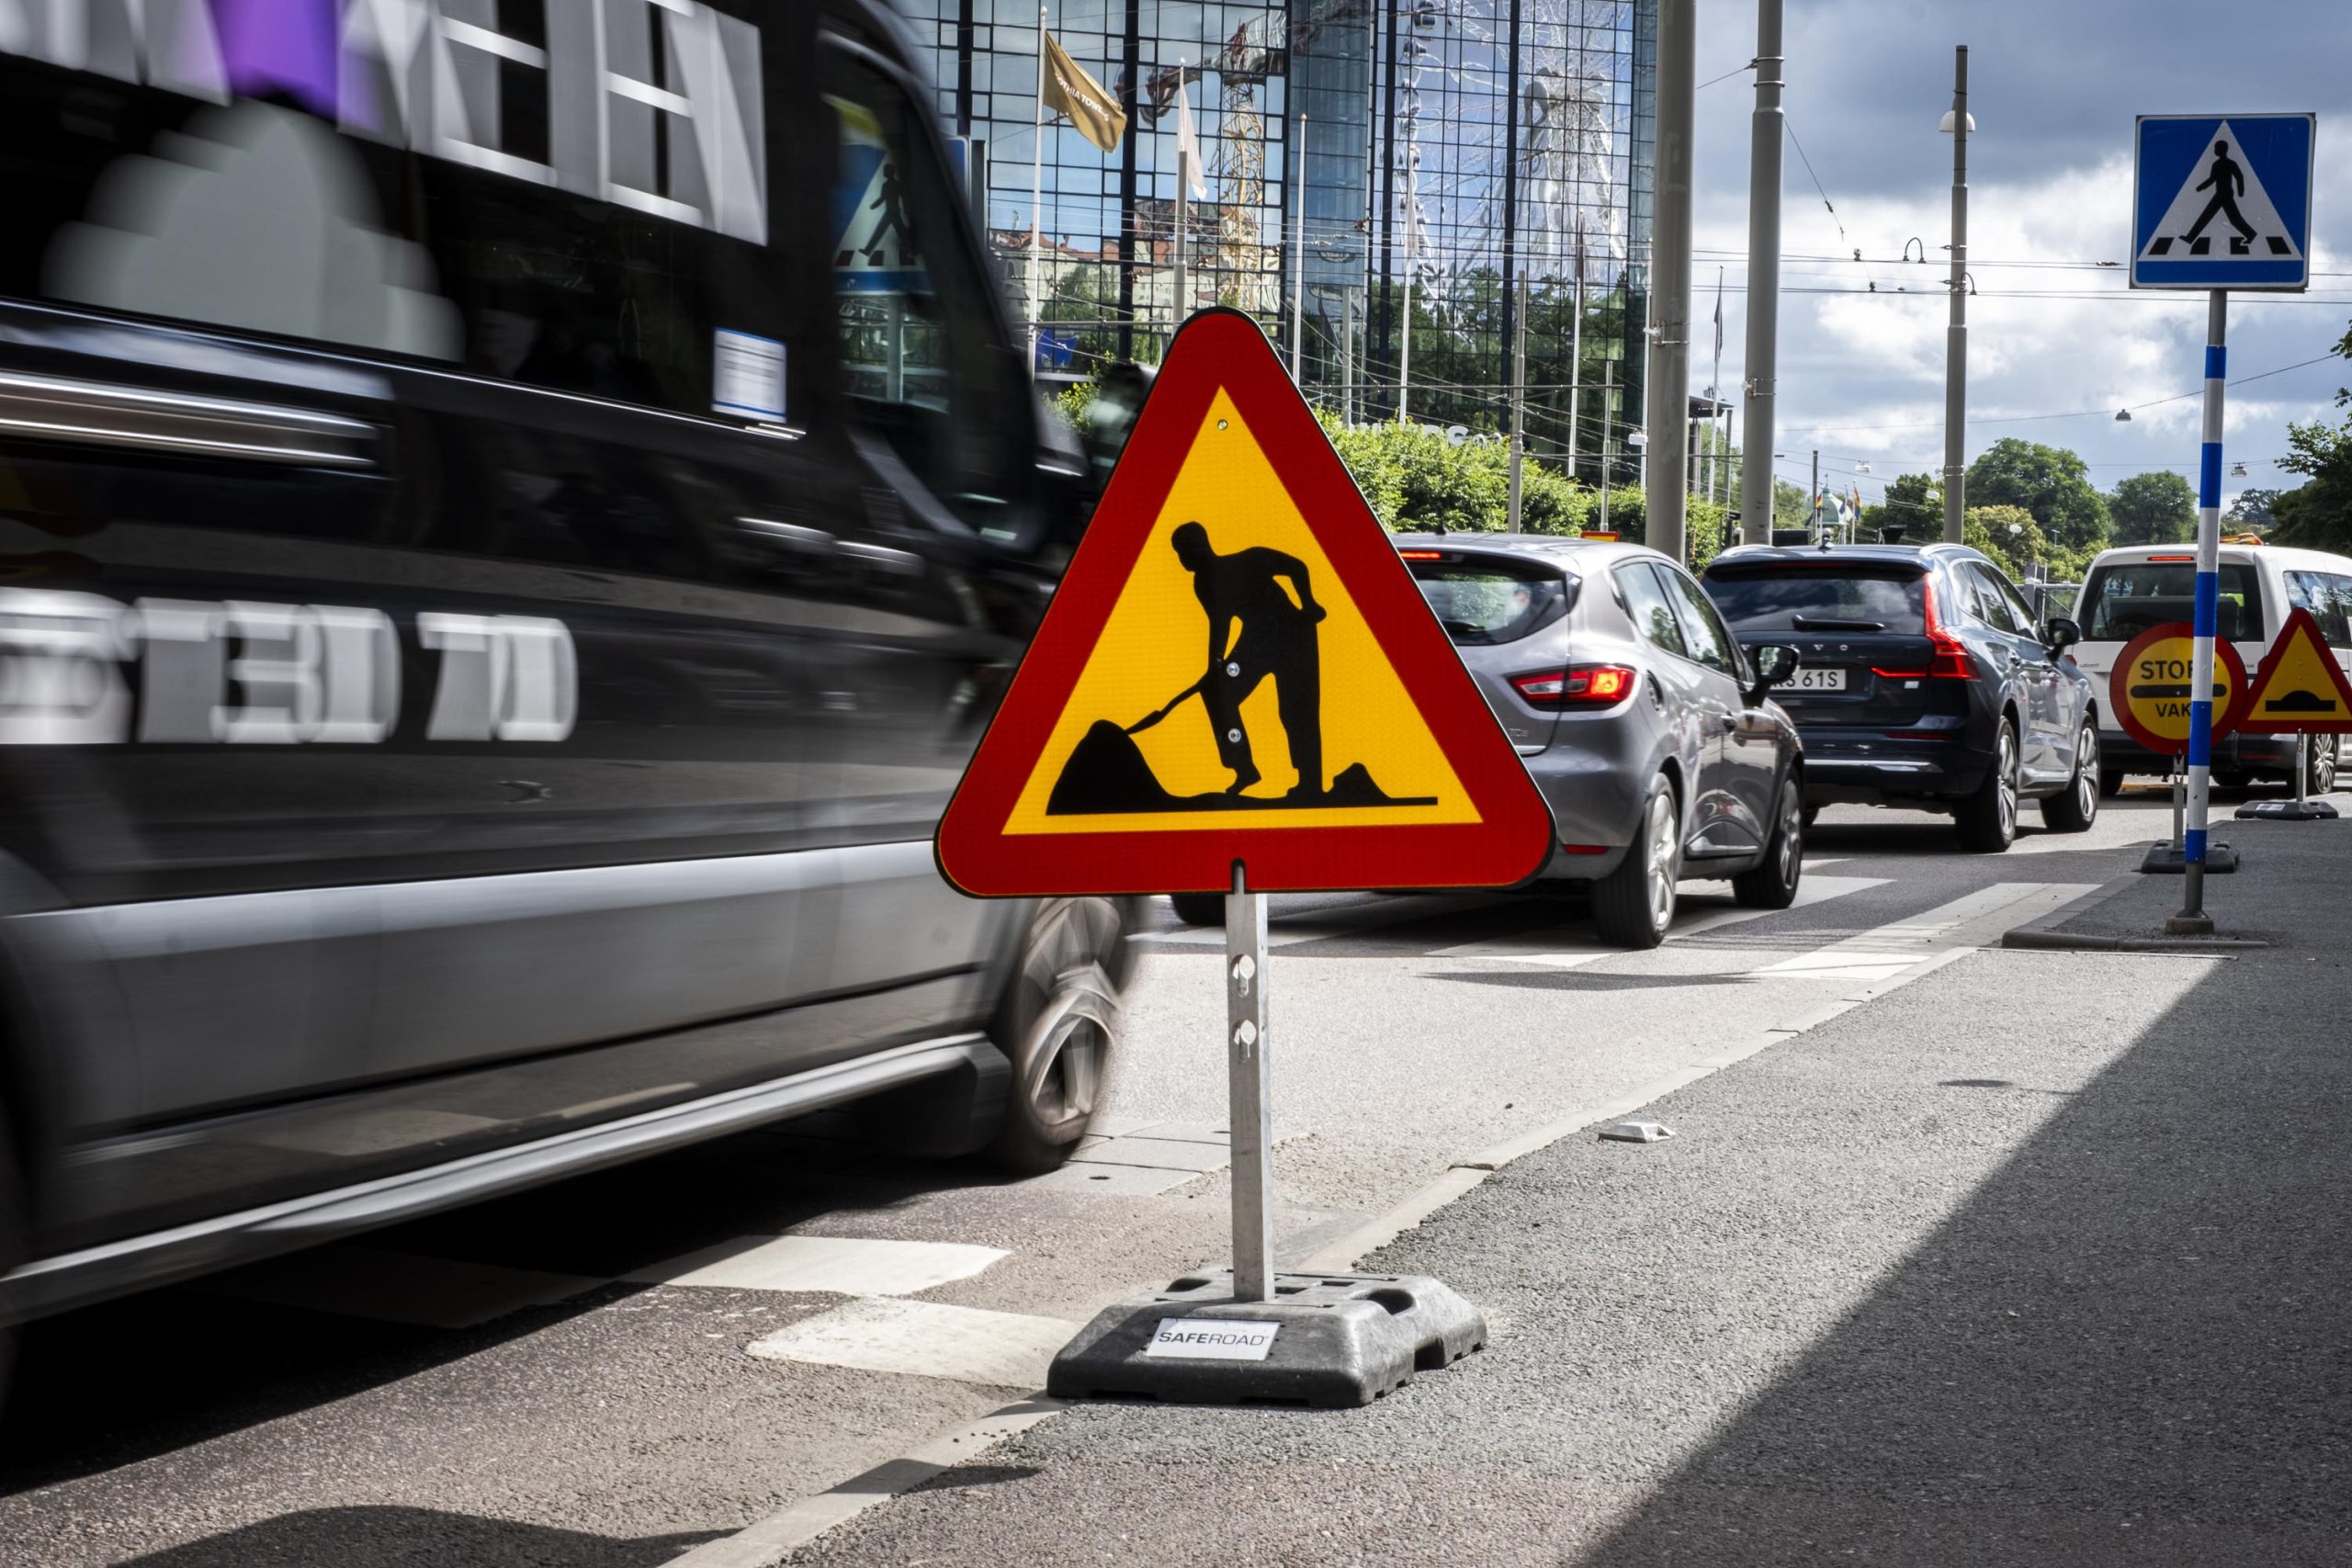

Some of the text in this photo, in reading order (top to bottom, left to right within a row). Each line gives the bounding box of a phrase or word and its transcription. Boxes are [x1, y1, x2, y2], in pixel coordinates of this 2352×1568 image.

[1056, 73, 1109, 121] OTHIA TOWES
[1802, 671, 1838, 687] 61S
[2155, 703, 2191, 717] VAK
[1158, 1332, 1265, 1346] SAFEROAD
